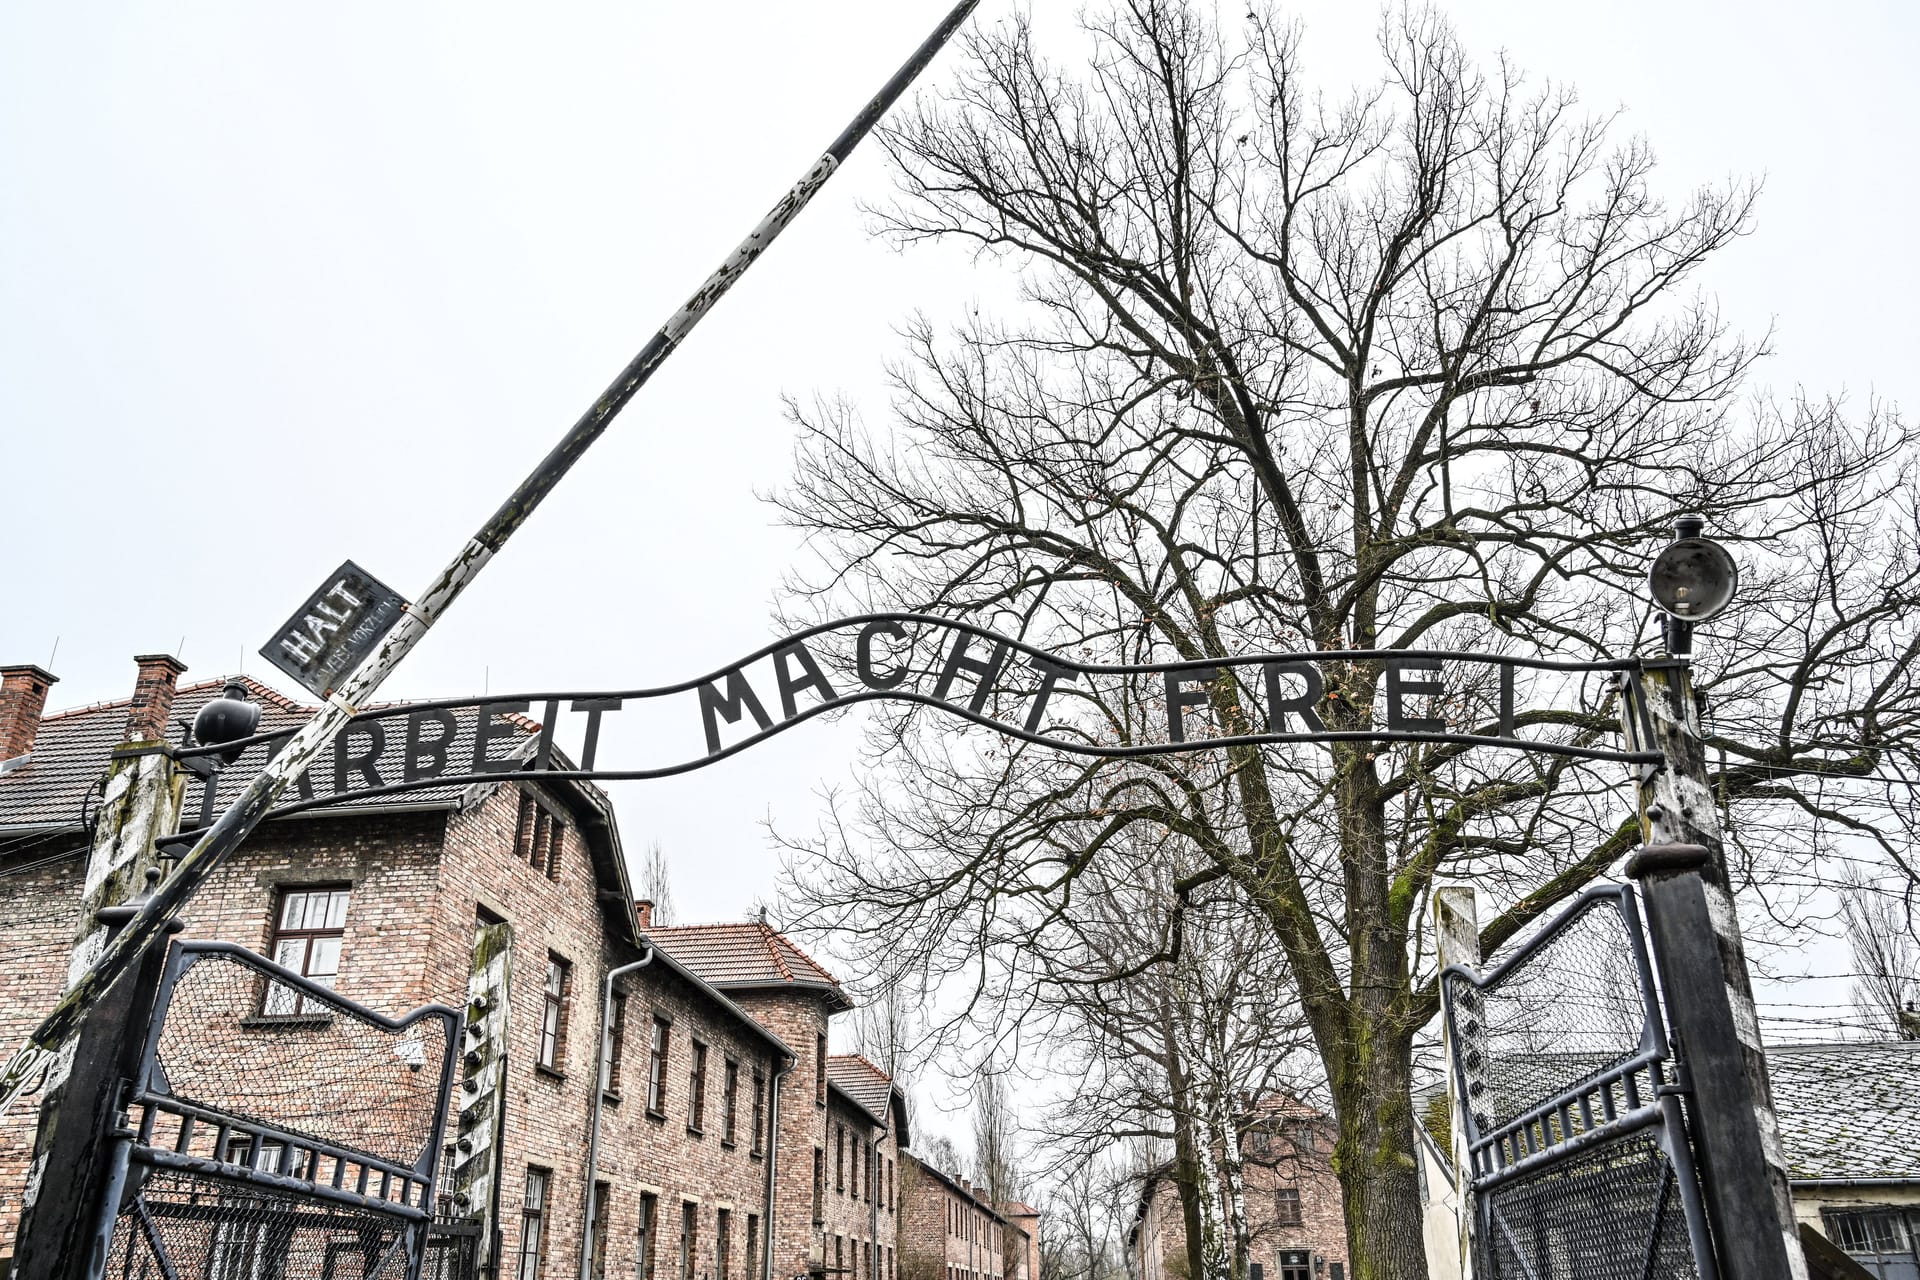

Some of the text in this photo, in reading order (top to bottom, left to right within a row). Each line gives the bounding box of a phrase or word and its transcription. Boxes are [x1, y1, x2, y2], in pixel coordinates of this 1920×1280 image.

[280, 579, 362, 664] HALT
[697, 619, 1079, 757] MACHT
[1164, 656, 1514, 743] FREI
